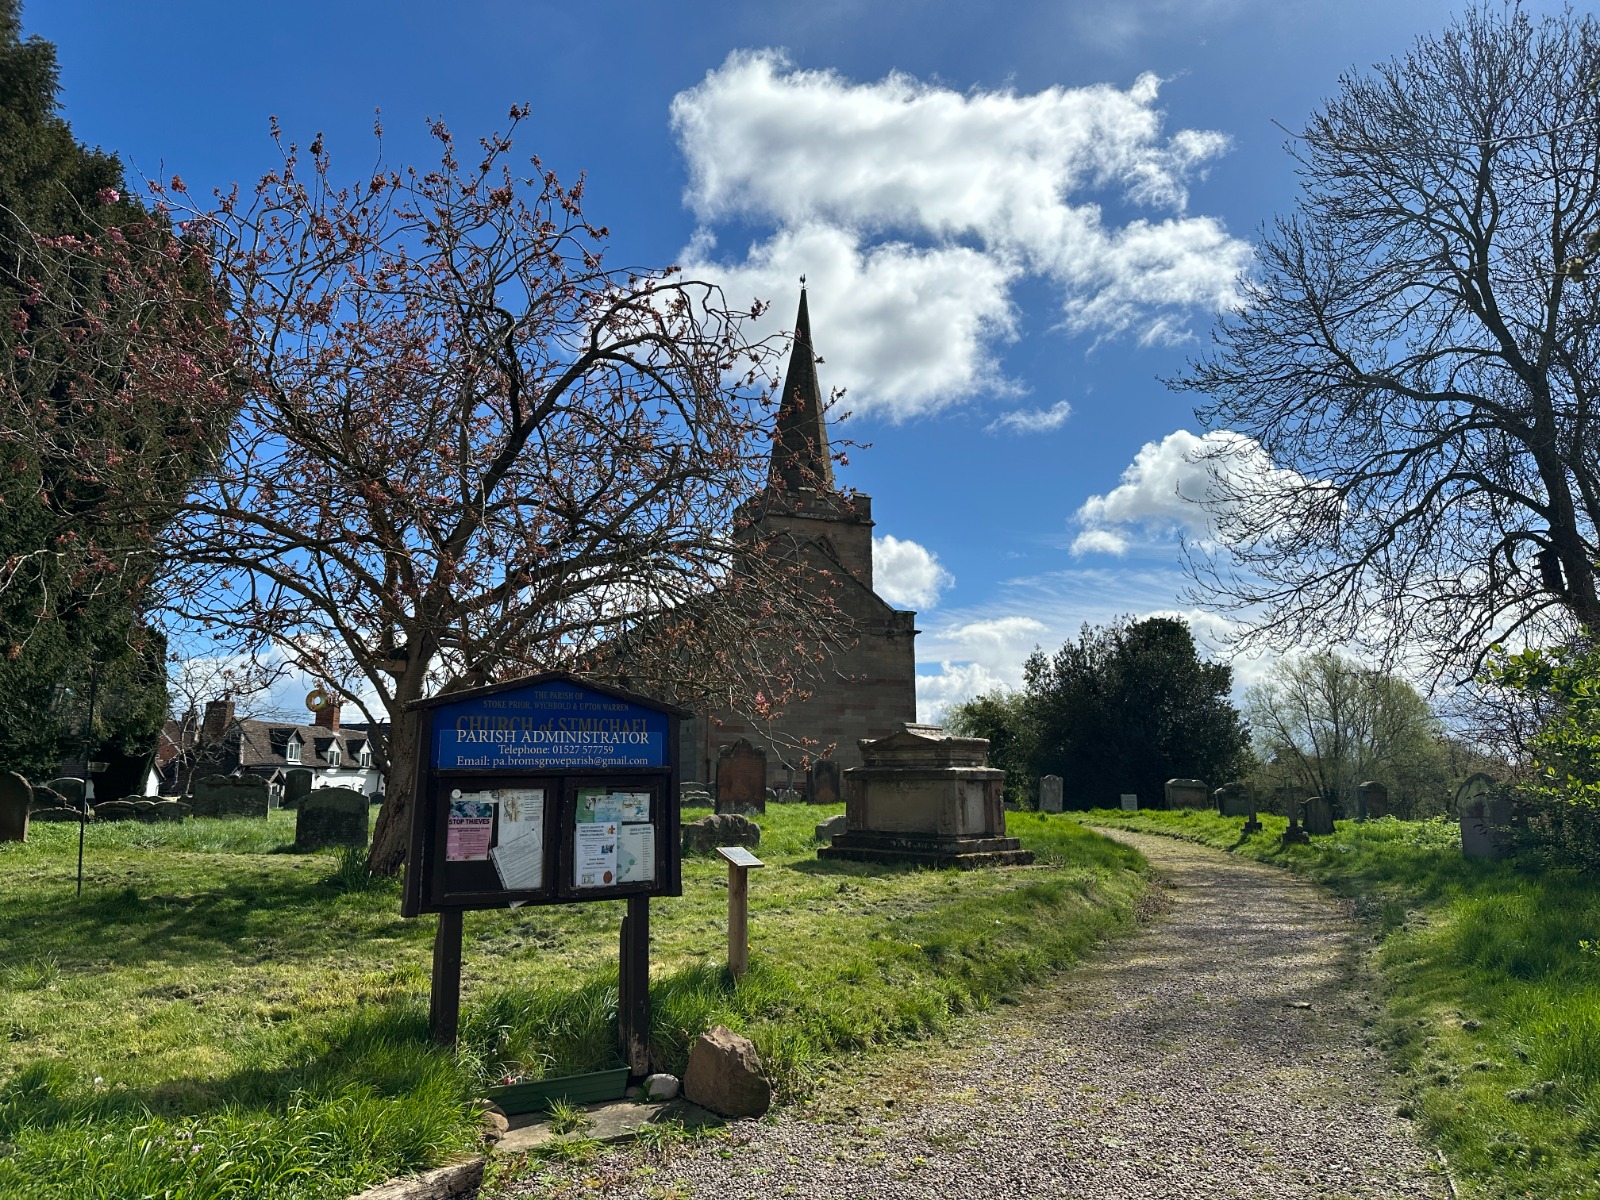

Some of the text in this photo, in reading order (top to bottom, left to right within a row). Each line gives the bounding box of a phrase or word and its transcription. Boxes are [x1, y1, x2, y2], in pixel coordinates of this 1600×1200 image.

[535, 691, 584, 700] THE PARISH OF
[483, 700, 506, 708] STOKE
[534, 701, 571, 710] WYCHBOLD
[580, 703, 602, 711] UPTON
[603, 703, 628, 712] WARREN
[456, 716, 533, 730] CHURCH
[456, 730, 649, 744] PARISH ADMINISTRATOR
[498, 744, 614, 756] Telephone: 01527 577759
[457, 756, 648, 768] Email: pa.bromsgroveparish@gmail.com
